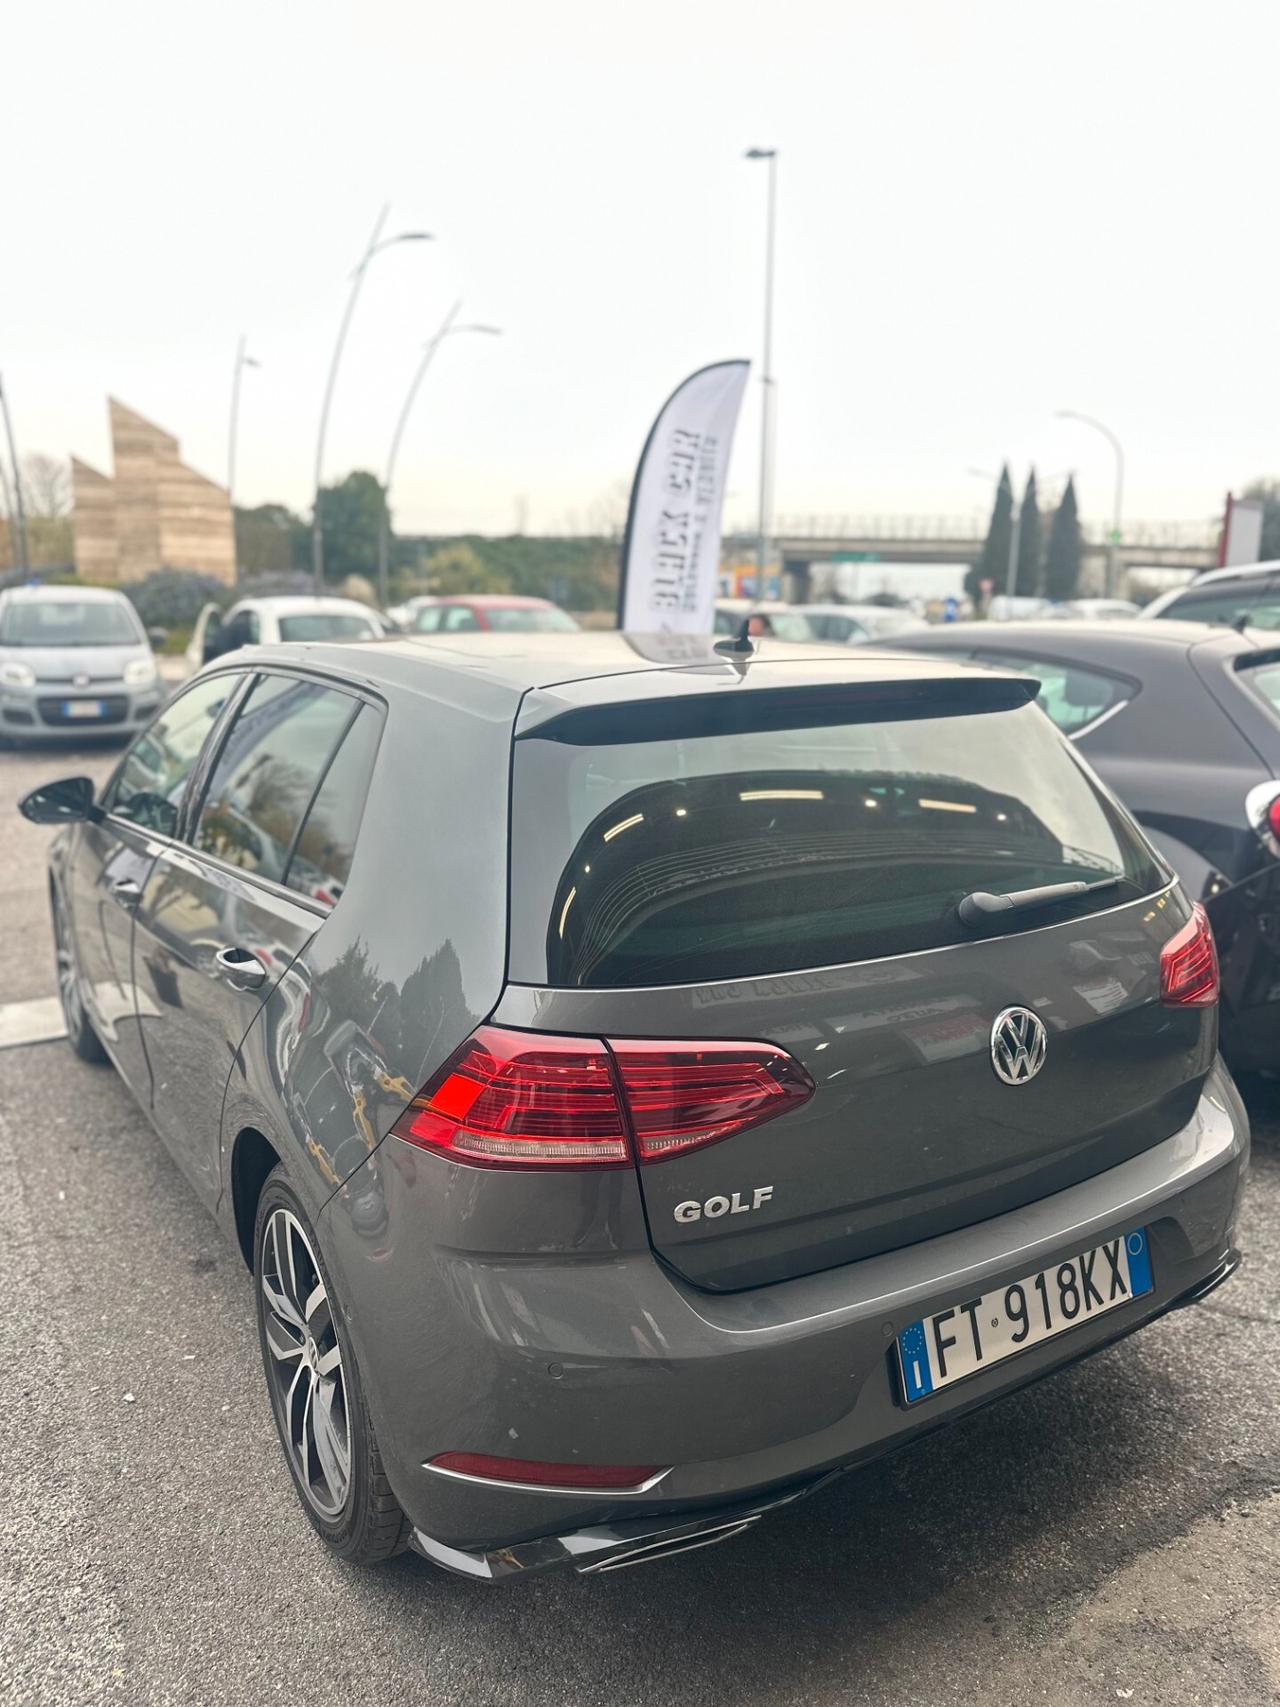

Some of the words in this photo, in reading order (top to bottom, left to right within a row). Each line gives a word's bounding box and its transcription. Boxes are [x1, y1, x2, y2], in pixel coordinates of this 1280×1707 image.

[667, 428, 701, 496] CAR
[653, 508, 689, 610] BLACK
[674, 1186, 773, 1223] GOLF
[932, 1297, 982, 1378] FT
[1004, 1239, 1128, 1343] 918KX
